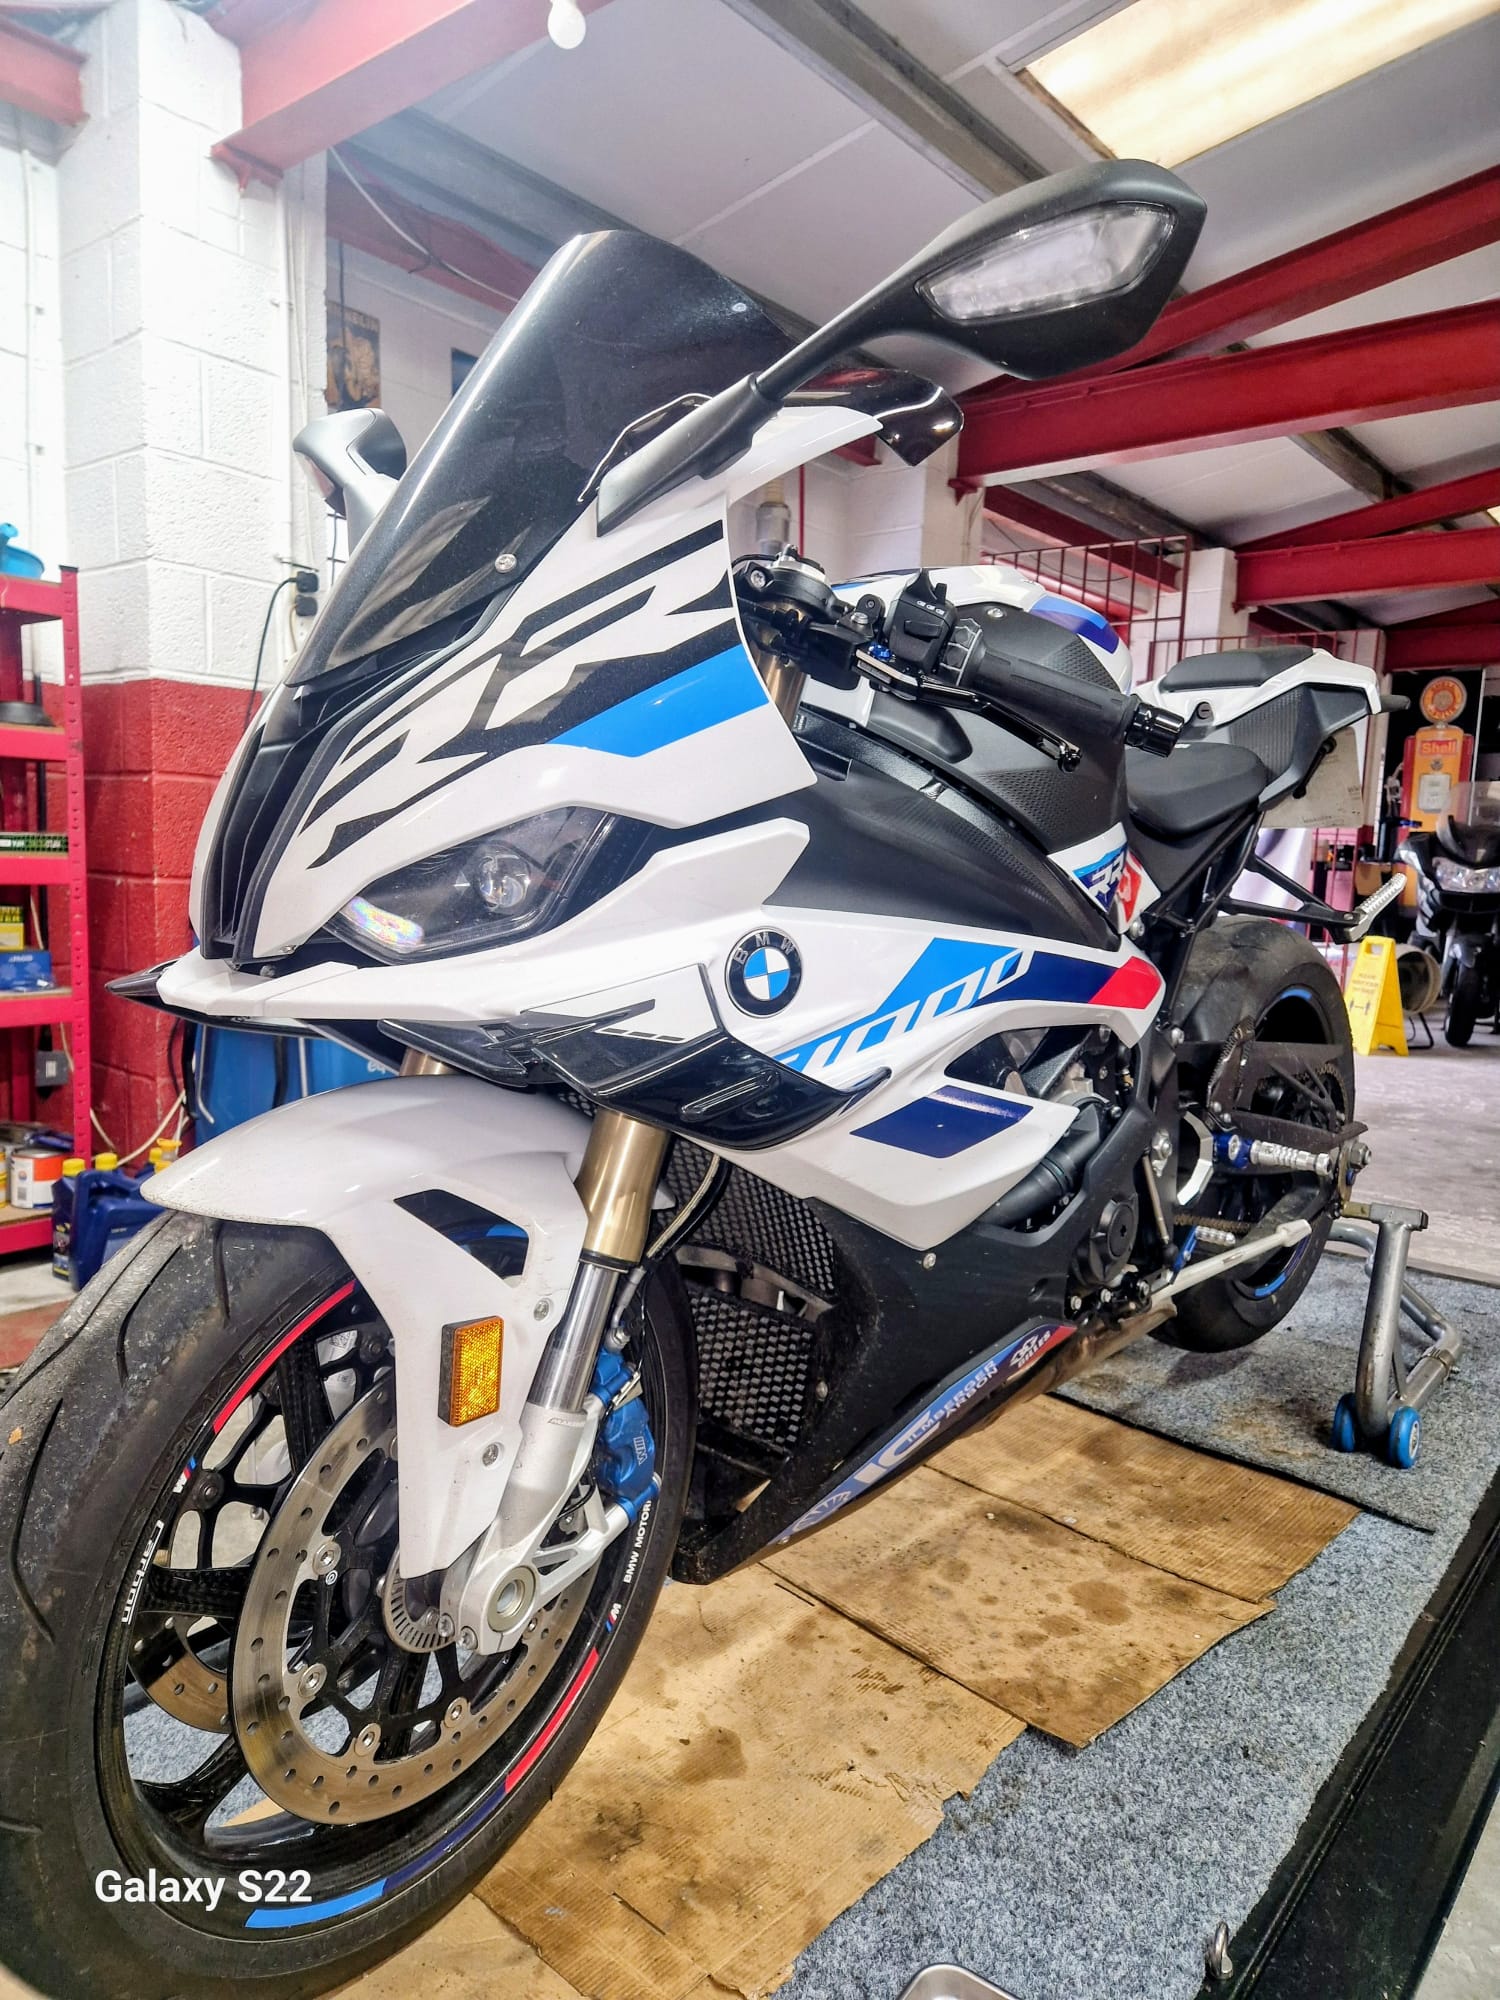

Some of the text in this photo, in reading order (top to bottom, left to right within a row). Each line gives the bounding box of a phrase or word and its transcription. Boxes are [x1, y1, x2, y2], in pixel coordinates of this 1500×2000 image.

[1421, 741, 1456, 754] Shell
[733, 932, 796, 965] BMW
[623, 1551, 639, 1584] BMW
